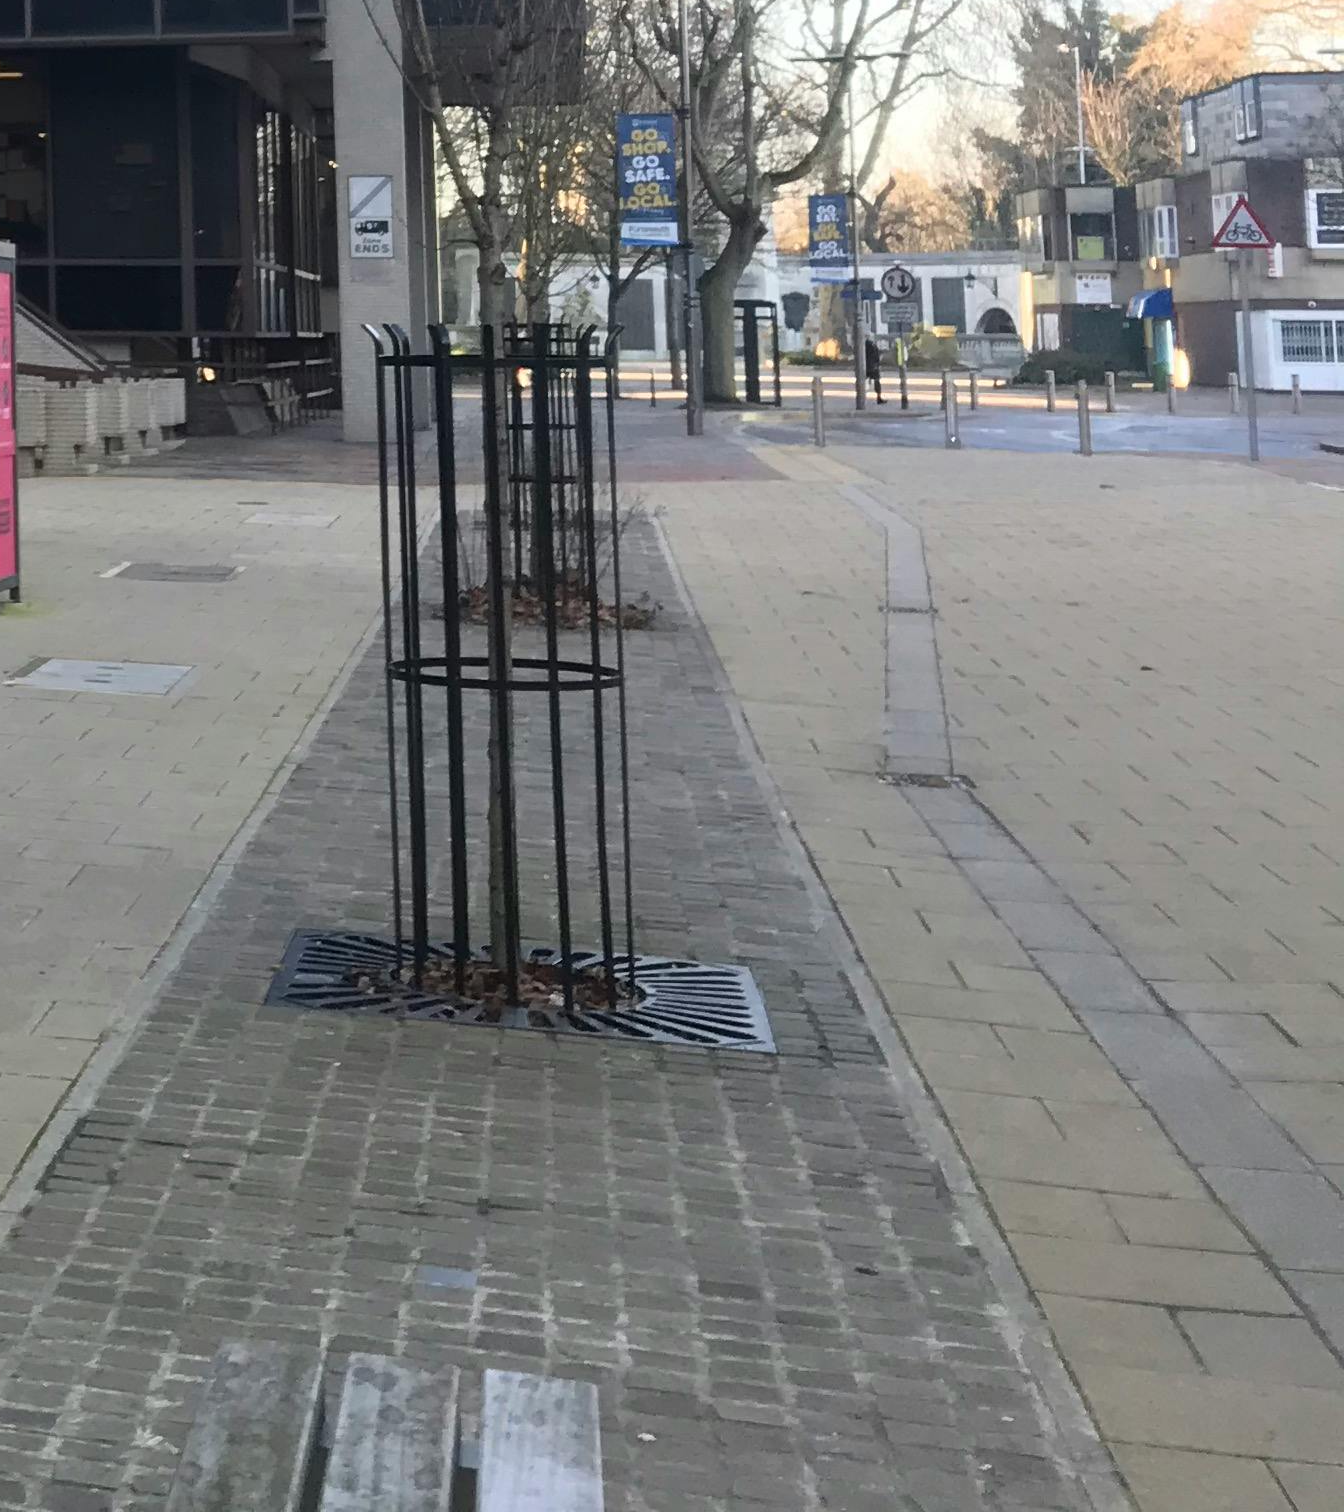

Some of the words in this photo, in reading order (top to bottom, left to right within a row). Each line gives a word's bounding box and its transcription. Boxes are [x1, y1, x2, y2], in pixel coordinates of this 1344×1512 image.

[631, 129, 657, 141] GO
[632, 155, 659, 169] GO
[625, 168, 670, 183] SAFE.
[633, 183, 660, 196] GO
[816, 204, 836, 215] GO
[355, 244, 390, 253] ENDS
